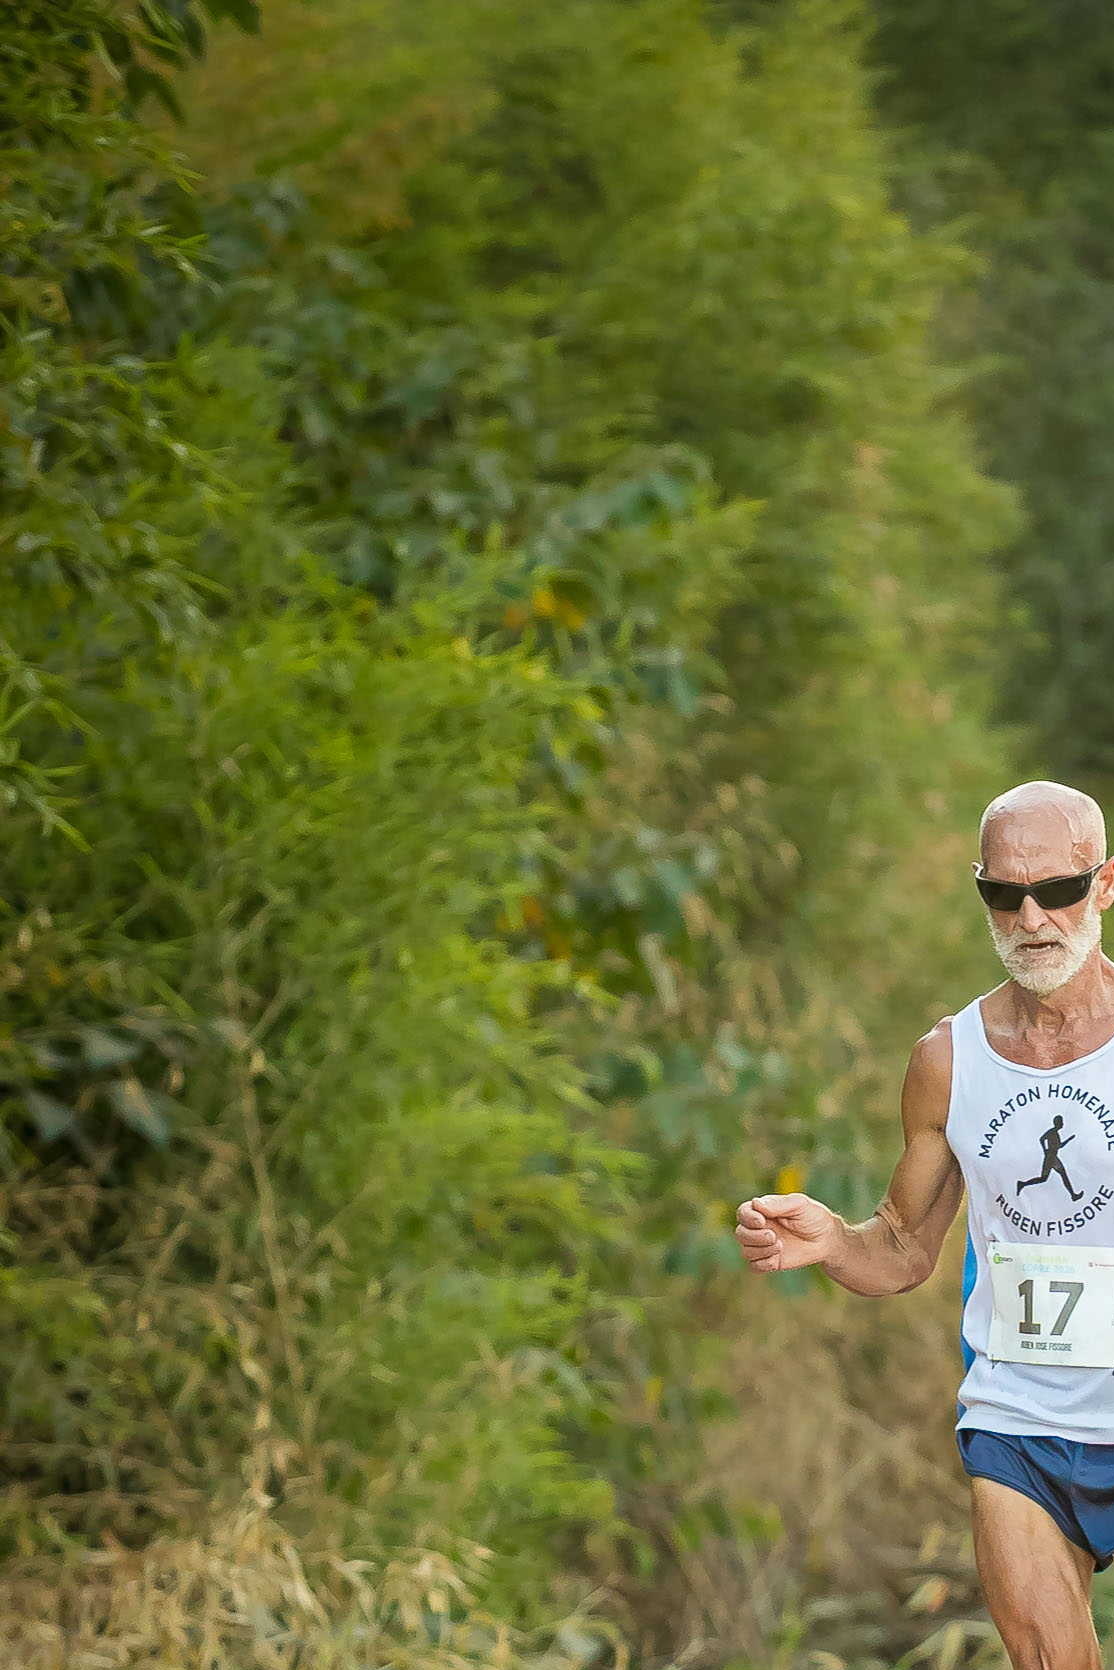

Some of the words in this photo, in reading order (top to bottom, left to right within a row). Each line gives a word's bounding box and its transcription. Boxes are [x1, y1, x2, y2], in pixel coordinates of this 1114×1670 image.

[978, 1085, 1041, 1159] MARATON
[995, 1193, 1041, 1236] RUBEN
[1047, 1184, 1114, 1237] FISSORE
[1018, 1279, 1084, 1336] 17
